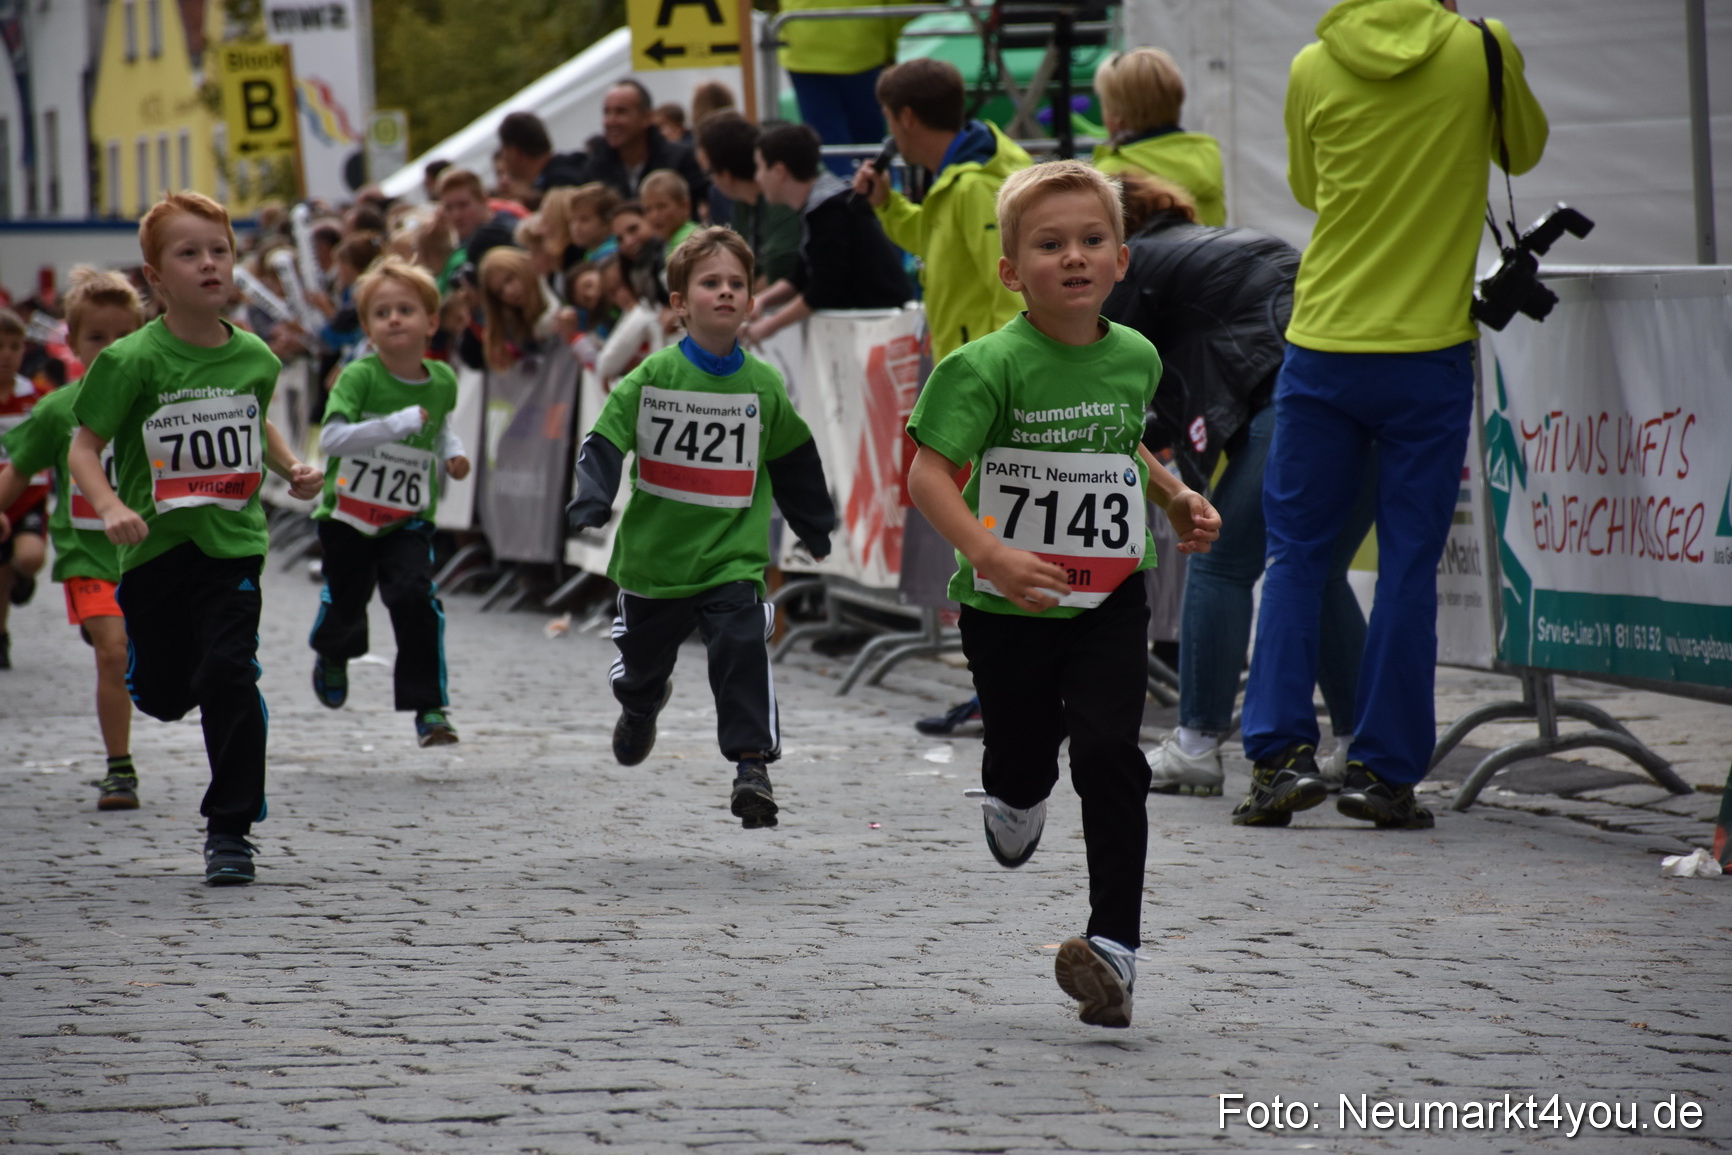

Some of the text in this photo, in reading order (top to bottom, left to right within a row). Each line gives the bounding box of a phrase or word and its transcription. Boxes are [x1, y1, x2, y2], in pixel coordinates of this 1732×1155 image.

[243, 79, 281, 132] B
[643, 397, 741, 416] PARTL Neumarkt
[1014, 401, 1115, 424] Neumarkter
[146, 408, 244, 431] PARTL Neumarkt
[651, 416, 745, 464] 7421
[1011, 423, 1099, 444] Stadtlauf
[159, 424, 252, 472] 7007
[349, 459, 422, 507] 7126
[986, 461, 1118, 484] PARTL Neumarkt
[1000, 485, 1130, 549] 7143
[1130, 545, 1136, 555] K
